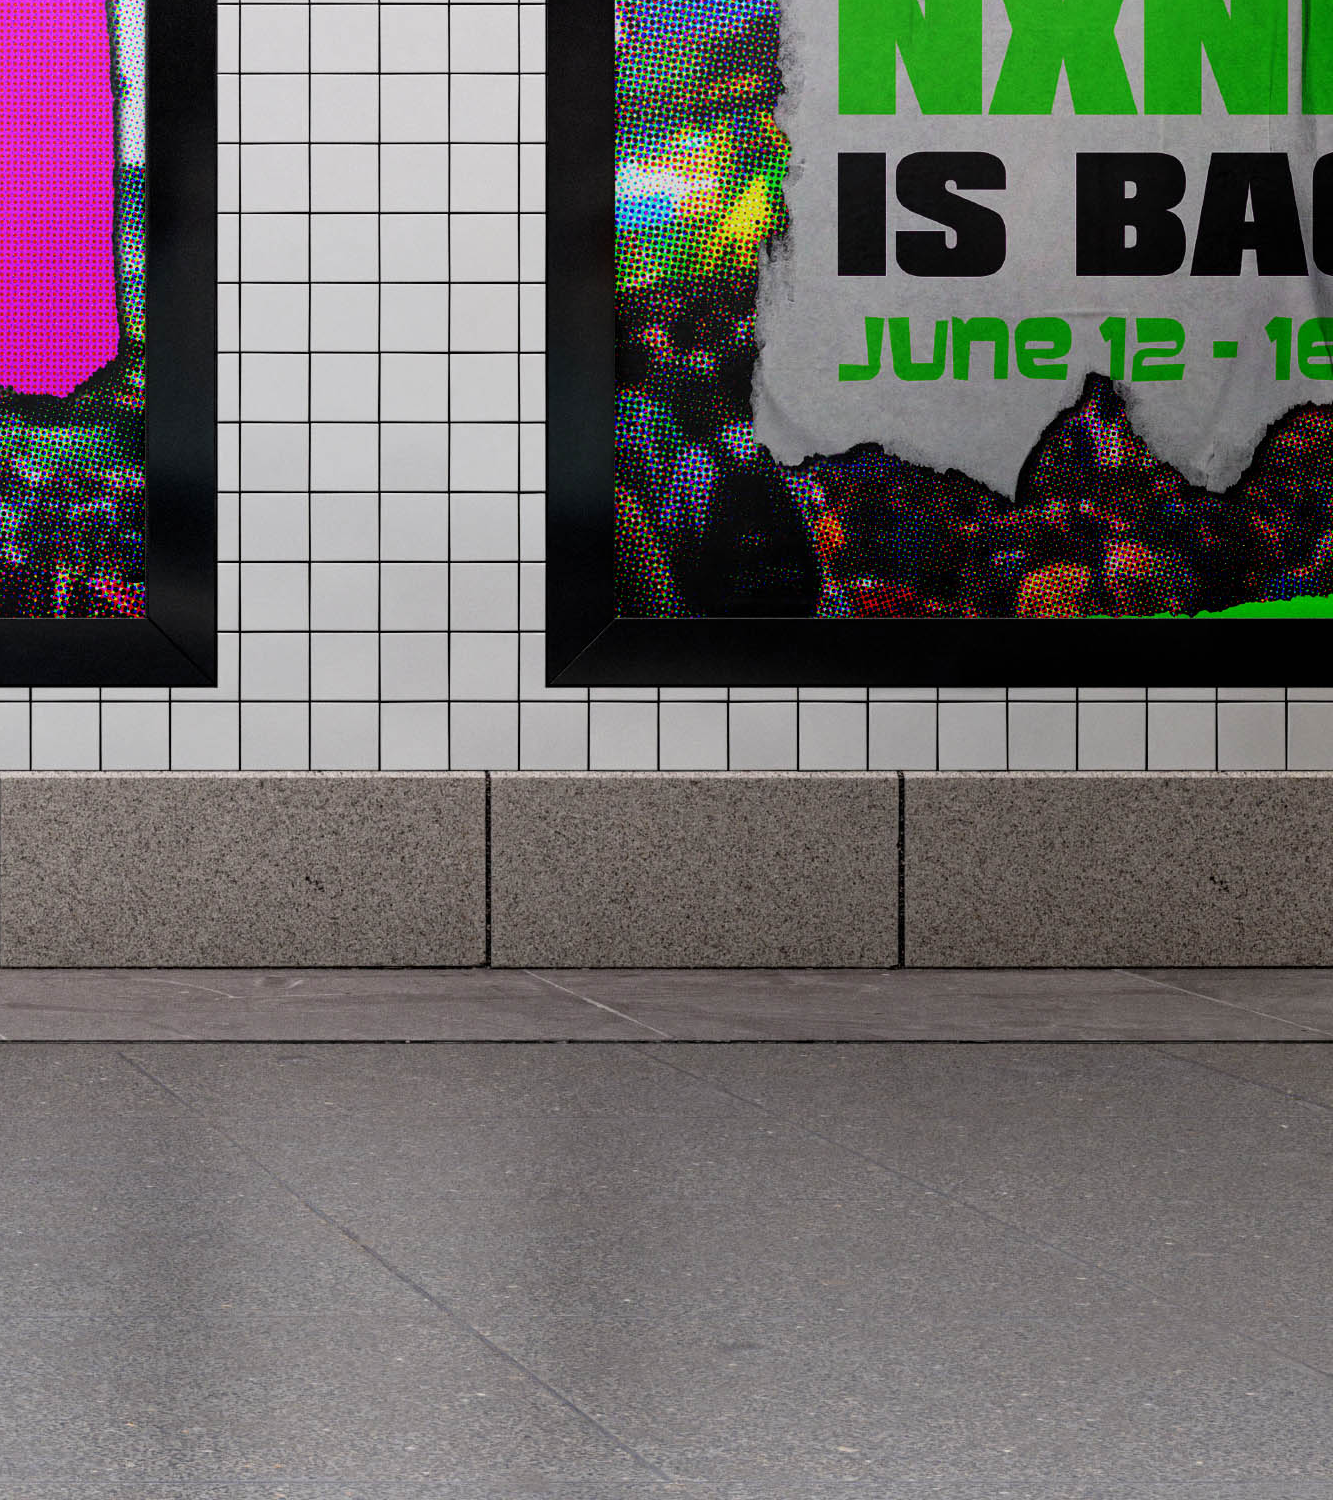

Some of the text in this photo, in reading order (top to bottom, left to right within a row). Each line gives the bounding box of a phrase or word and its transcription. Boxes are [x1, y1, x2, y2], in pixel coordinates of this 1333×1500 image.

[837, 151, 1333, 278] IS BA
[1101, 316, 1187, 382] 12
